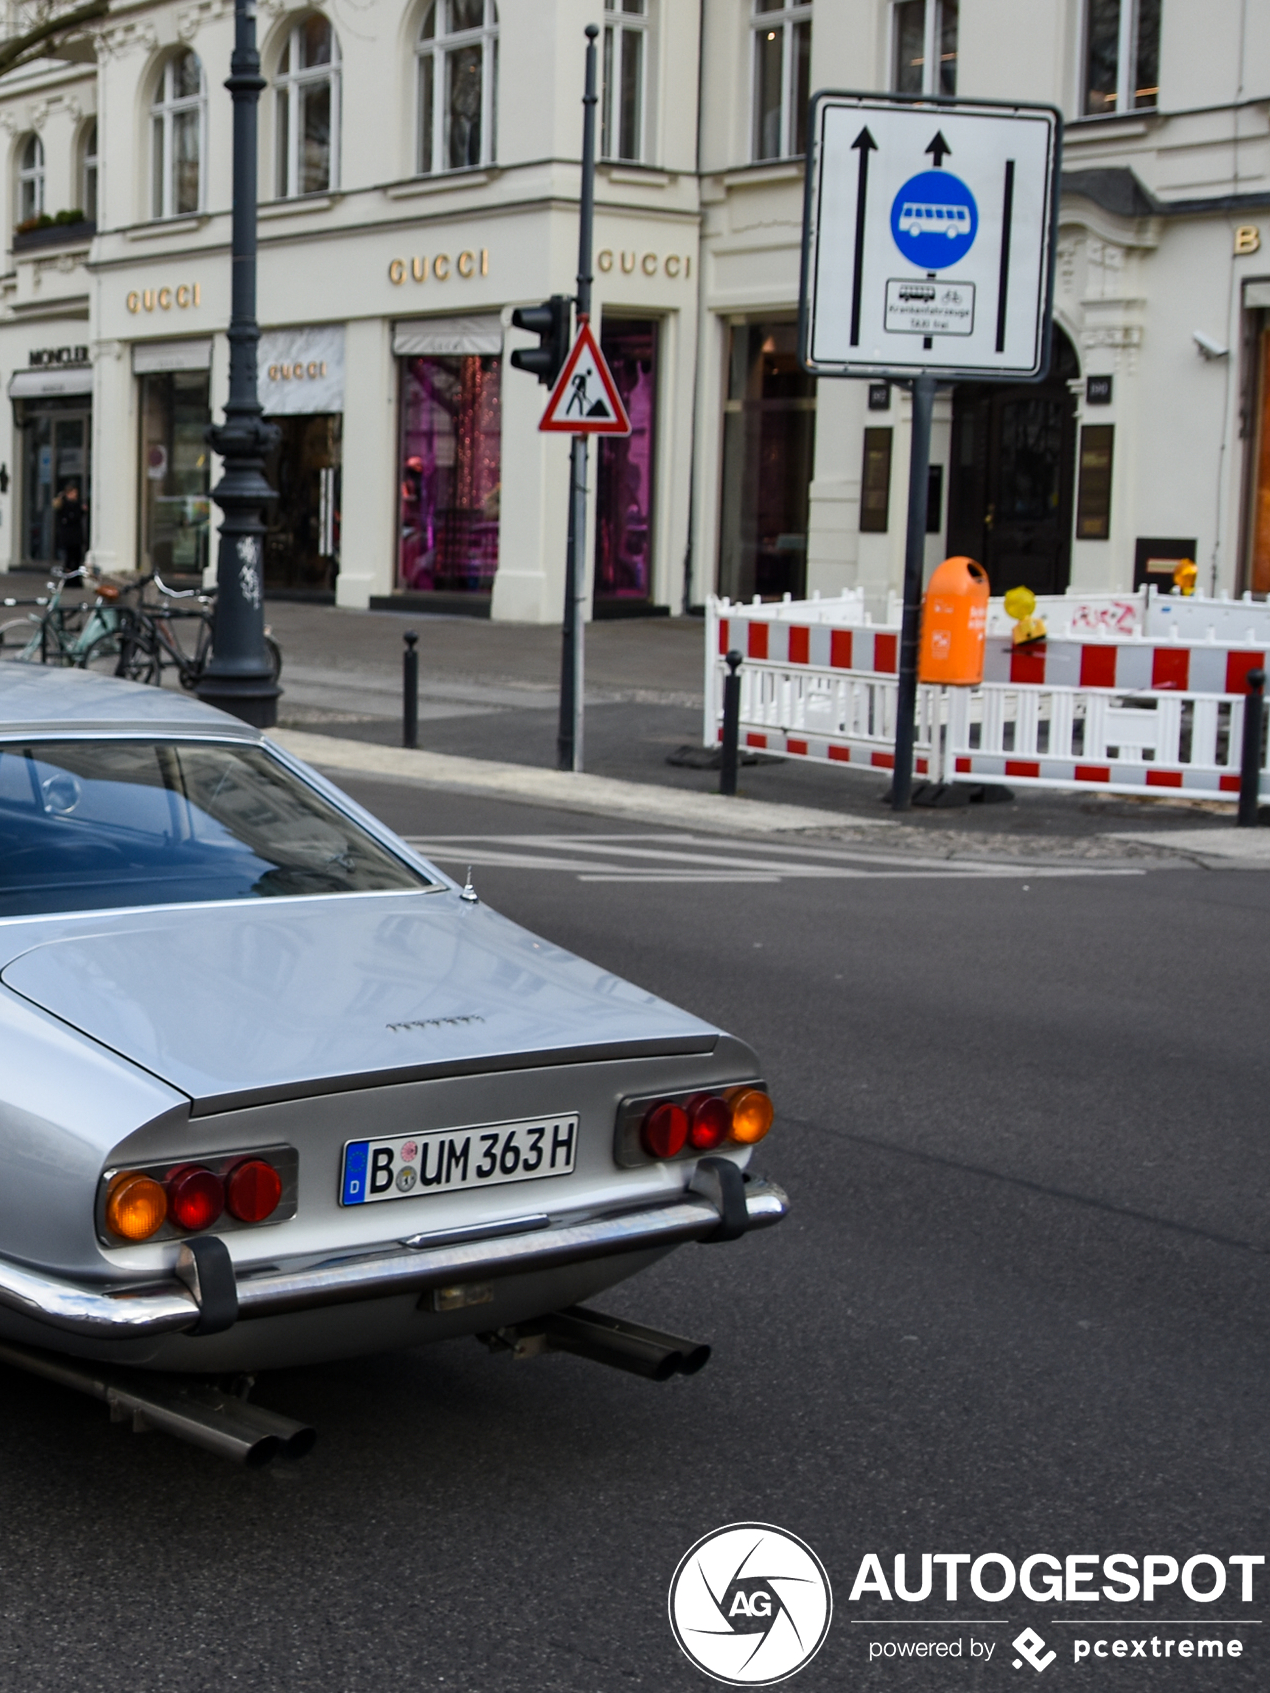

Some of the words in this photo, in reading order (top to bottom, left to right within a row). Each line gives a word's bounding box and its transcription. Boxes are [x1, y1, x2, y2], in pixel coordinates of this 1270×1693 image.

[1234, 225, 1261, 255] B
[389, 248, 489, 285] GUCCI
[597, 249, 691, 278] GUCCI
[126, 282, 202, 314] GUCCI
[268, 361, 328, 382] GUCCI
[369, 1146, 394, 1194] B
[349, 1180, 360, 1194] D
